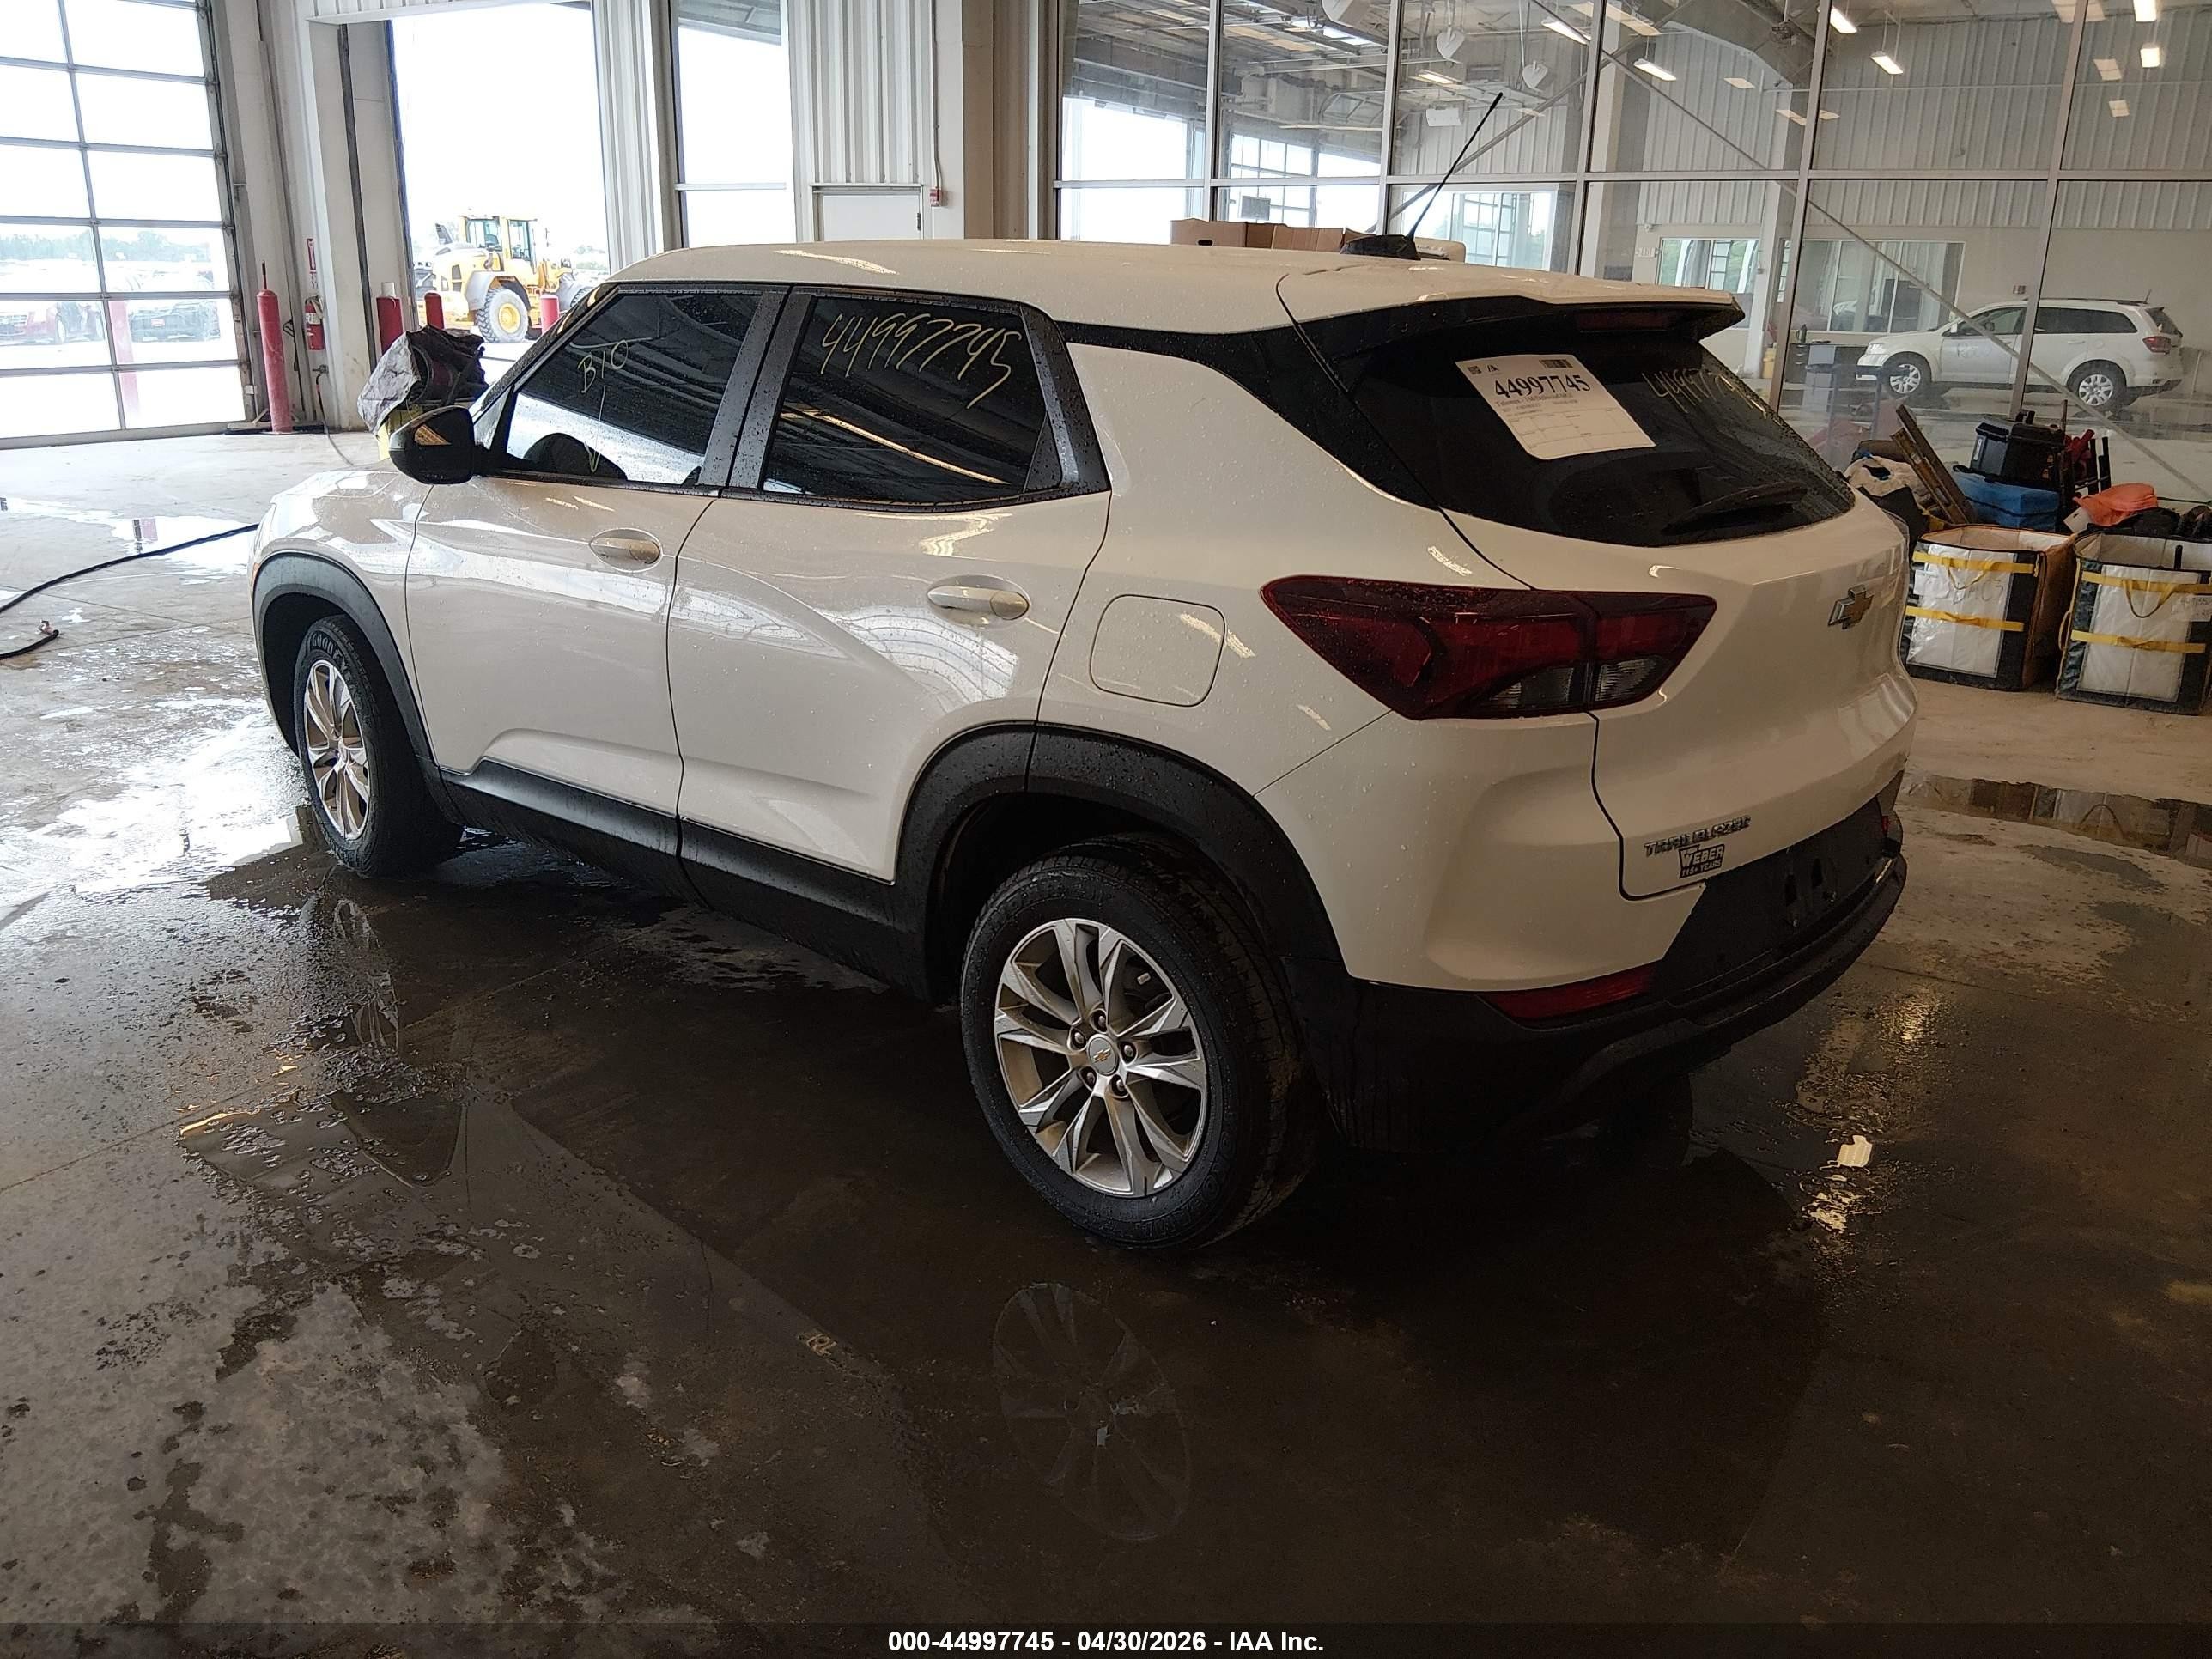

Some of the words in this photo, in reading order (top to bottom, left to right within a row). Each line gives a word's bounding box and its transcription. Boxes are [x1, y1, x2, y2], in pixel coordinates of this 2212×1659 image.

[820, 313, 1022, 410] 44997745
[1494, 374, 1591, 398] 44997745
[1680, 846, 1724, 868] WEBER
